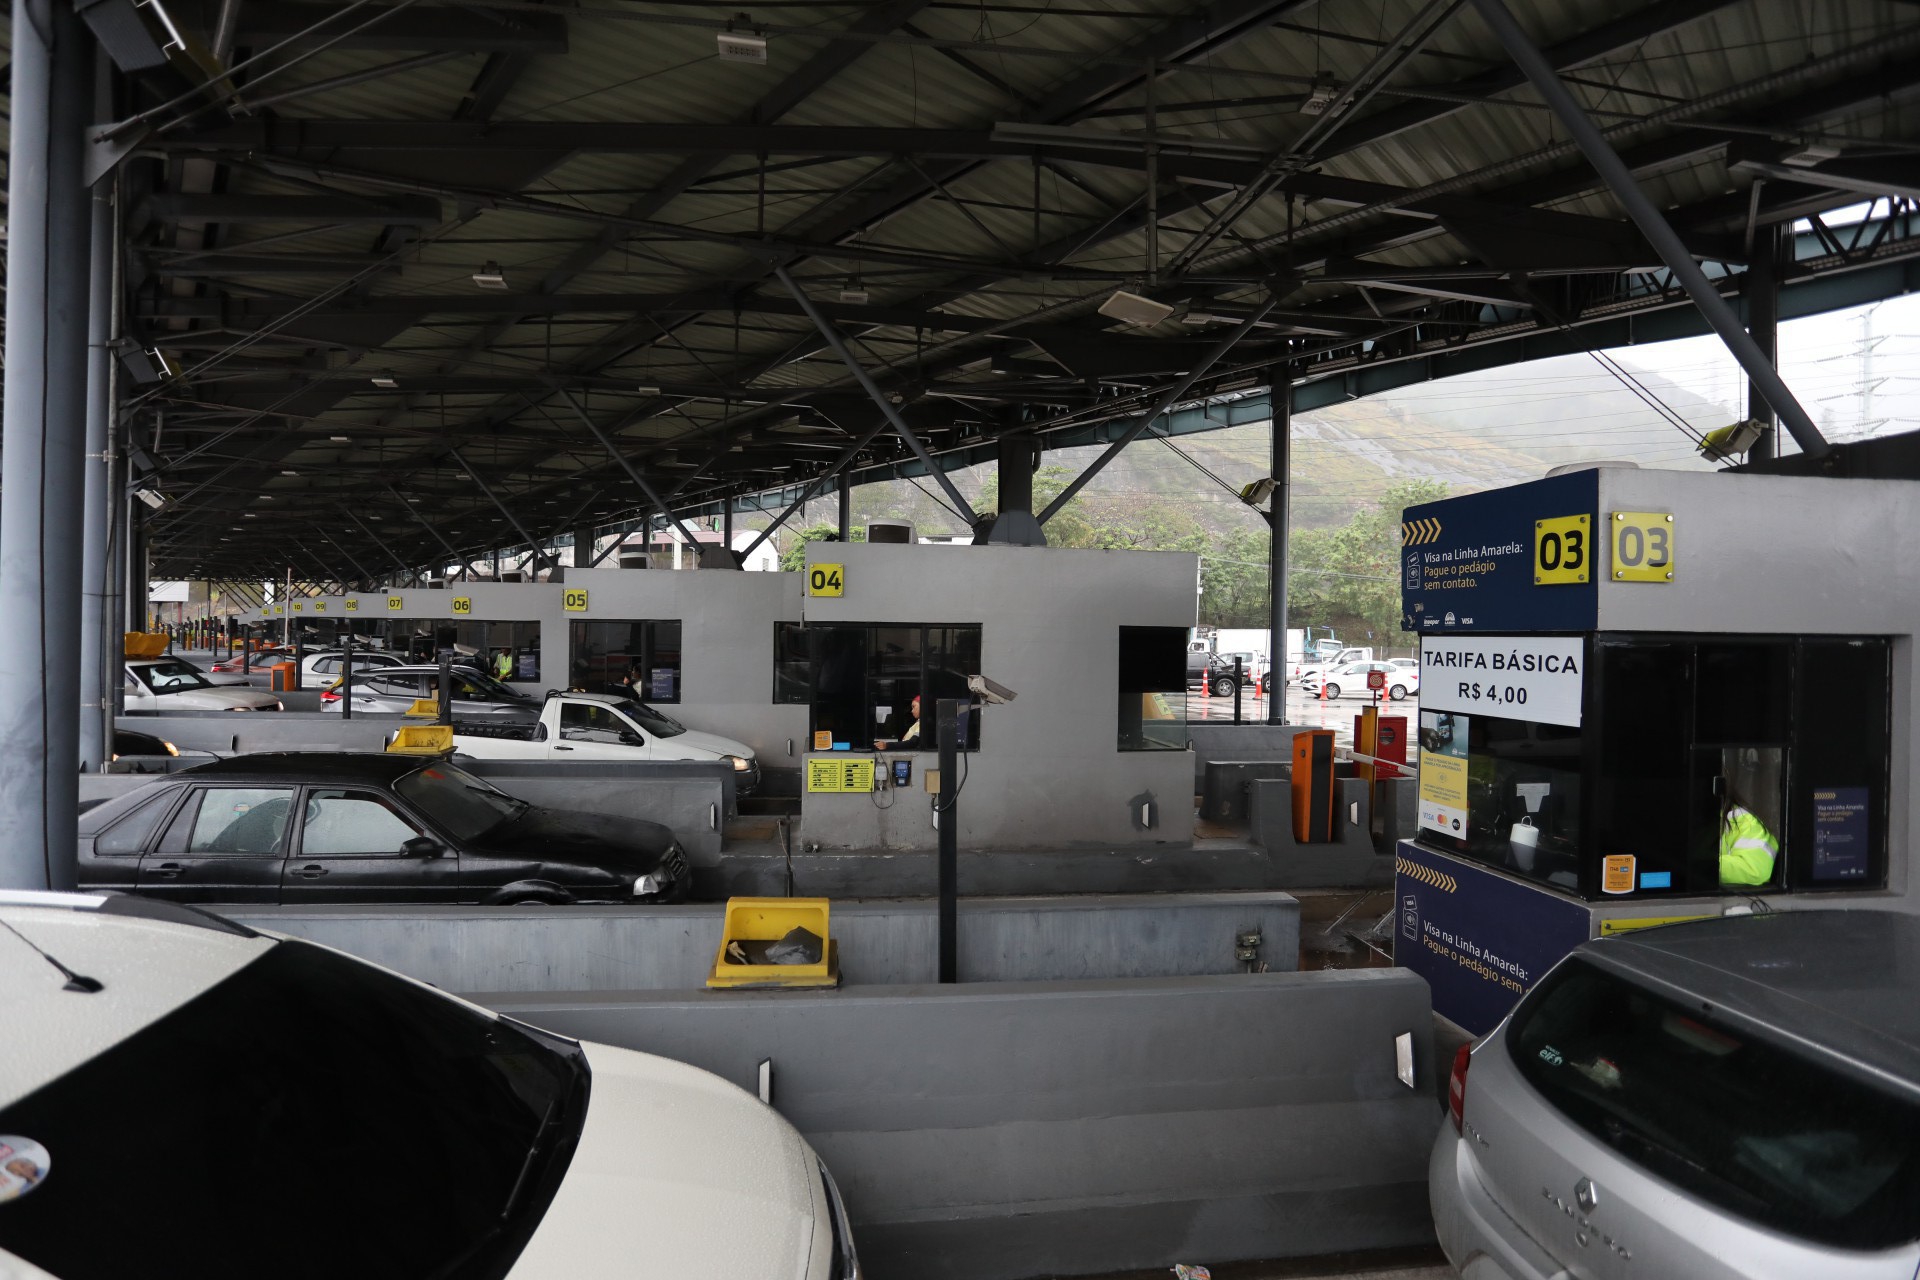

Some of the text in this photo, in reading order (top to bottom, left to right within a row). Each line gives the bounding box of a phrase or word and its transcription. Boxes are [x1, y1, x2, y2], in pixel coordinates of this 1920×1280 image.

[1424, 553, 1440, 563] Visa
[1442, 551, 1453, 561] na
[1454, 547, 1478, 560] Linha
[1480, 541, 1523, 557] Amarela:
[1539, 530, 1583, 571] 03
[1619, 526, 1669, 568] 03
[1424, 560, 1496, 578] Pague o pedágio
[811, 570, 842, 590] 04
[1424, 577, 1478, 590] sem contato.
[346, 601, 357, 610] 08
[389, 599, 401, 608] 07
[453, 600, 469, 611] 06
[566, 594, 586, 607] 05
[1424, 649, 1579, 674] TARIFA BÁSICA
[1458, 682, 1528, 705] R$ 4,00
[1423, 920, 1528, 981] Visa na Linha Amarela:
[1423, 934, 1522, 994] Pague o pedágio sem
